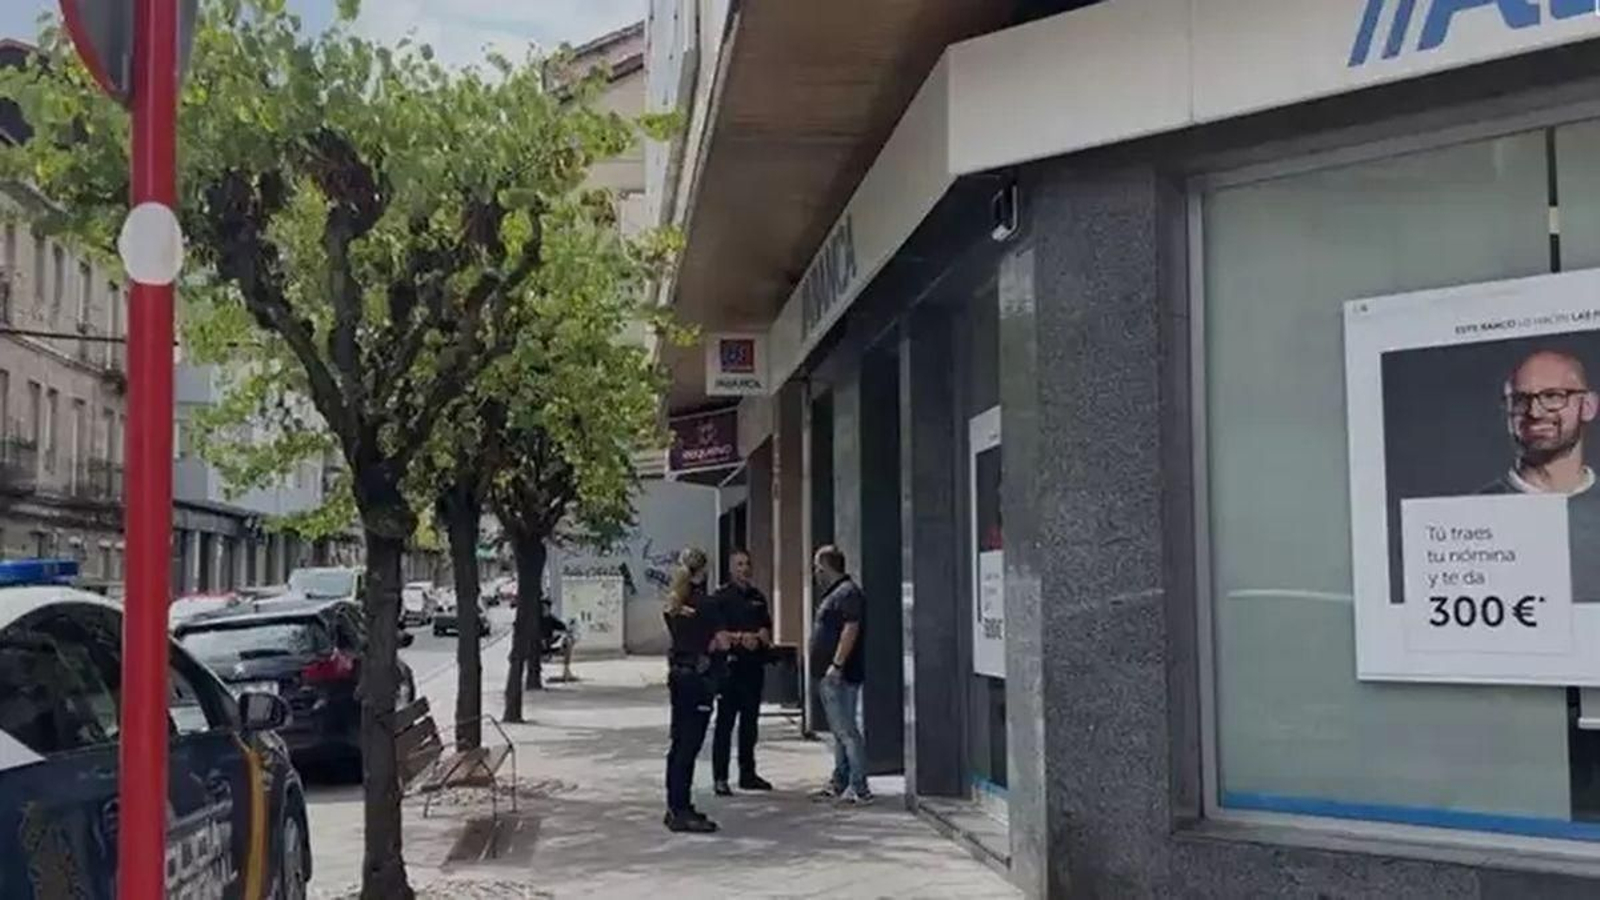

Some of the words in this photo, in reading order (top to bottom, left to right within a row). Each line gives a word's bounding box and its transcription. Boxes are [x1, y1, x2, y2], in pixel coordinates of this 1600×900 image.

[1455, 324, 1478, 335] ESTE
[1426, 525, 1446, 541] Tú
[1450, 526, 1493, 541] traes
[1427, 550, 1446, 564] tu
[1449, 548, 1516, 563] nómina
[1428, 573, 1438, 588] y
[1442, 572, 1459, 585] te
[1463, 570, 1485, 586] da
